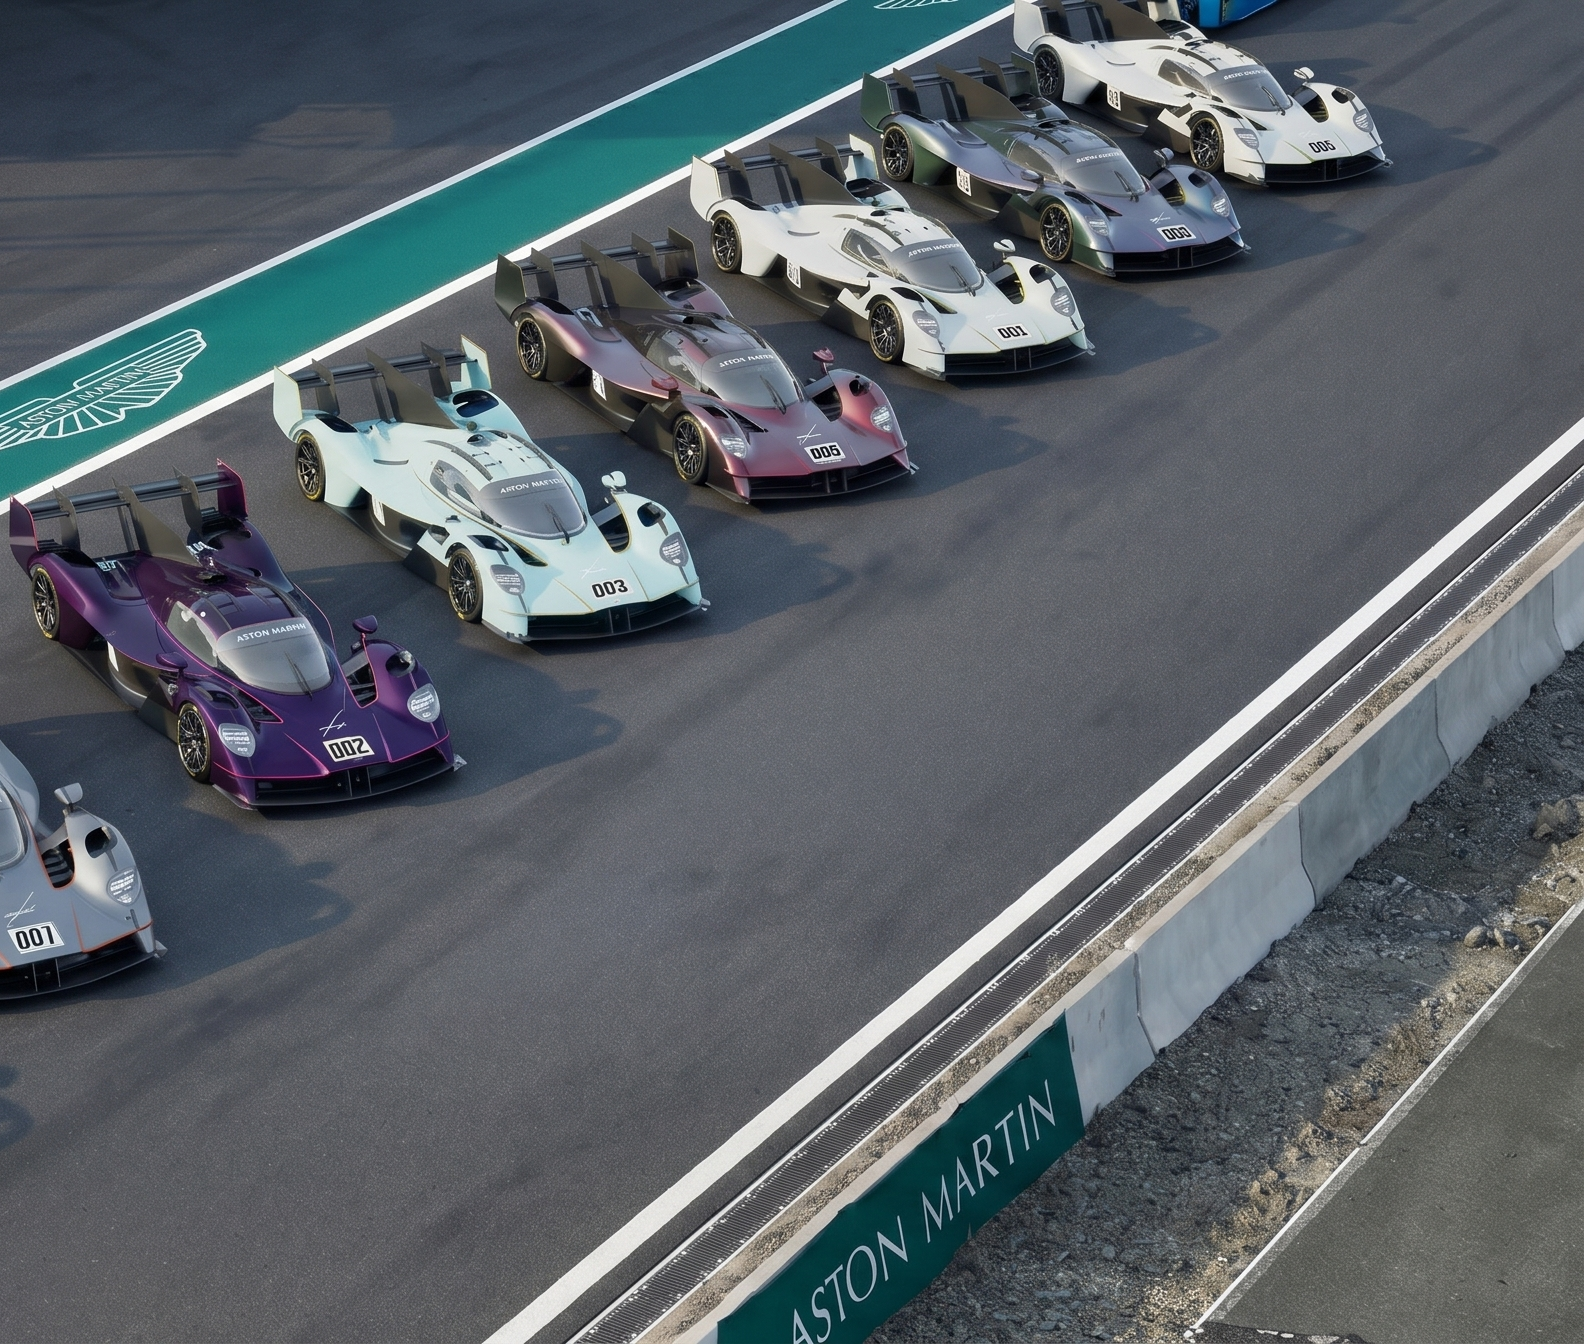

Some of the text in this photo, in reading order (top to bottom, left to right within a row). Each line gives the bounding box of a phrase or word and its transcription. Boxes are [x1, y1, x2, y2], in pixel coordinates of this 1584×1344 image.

[997, 325, 1029, 339] 001
[809, 444, 842, 460] 005
[591, 579, 628, 598] 003
[237, 629, 270, 643] ASTON
[328, 737, 369, 759] 002
[792, 1078, 1056, 1344] ASTON MARTIN
